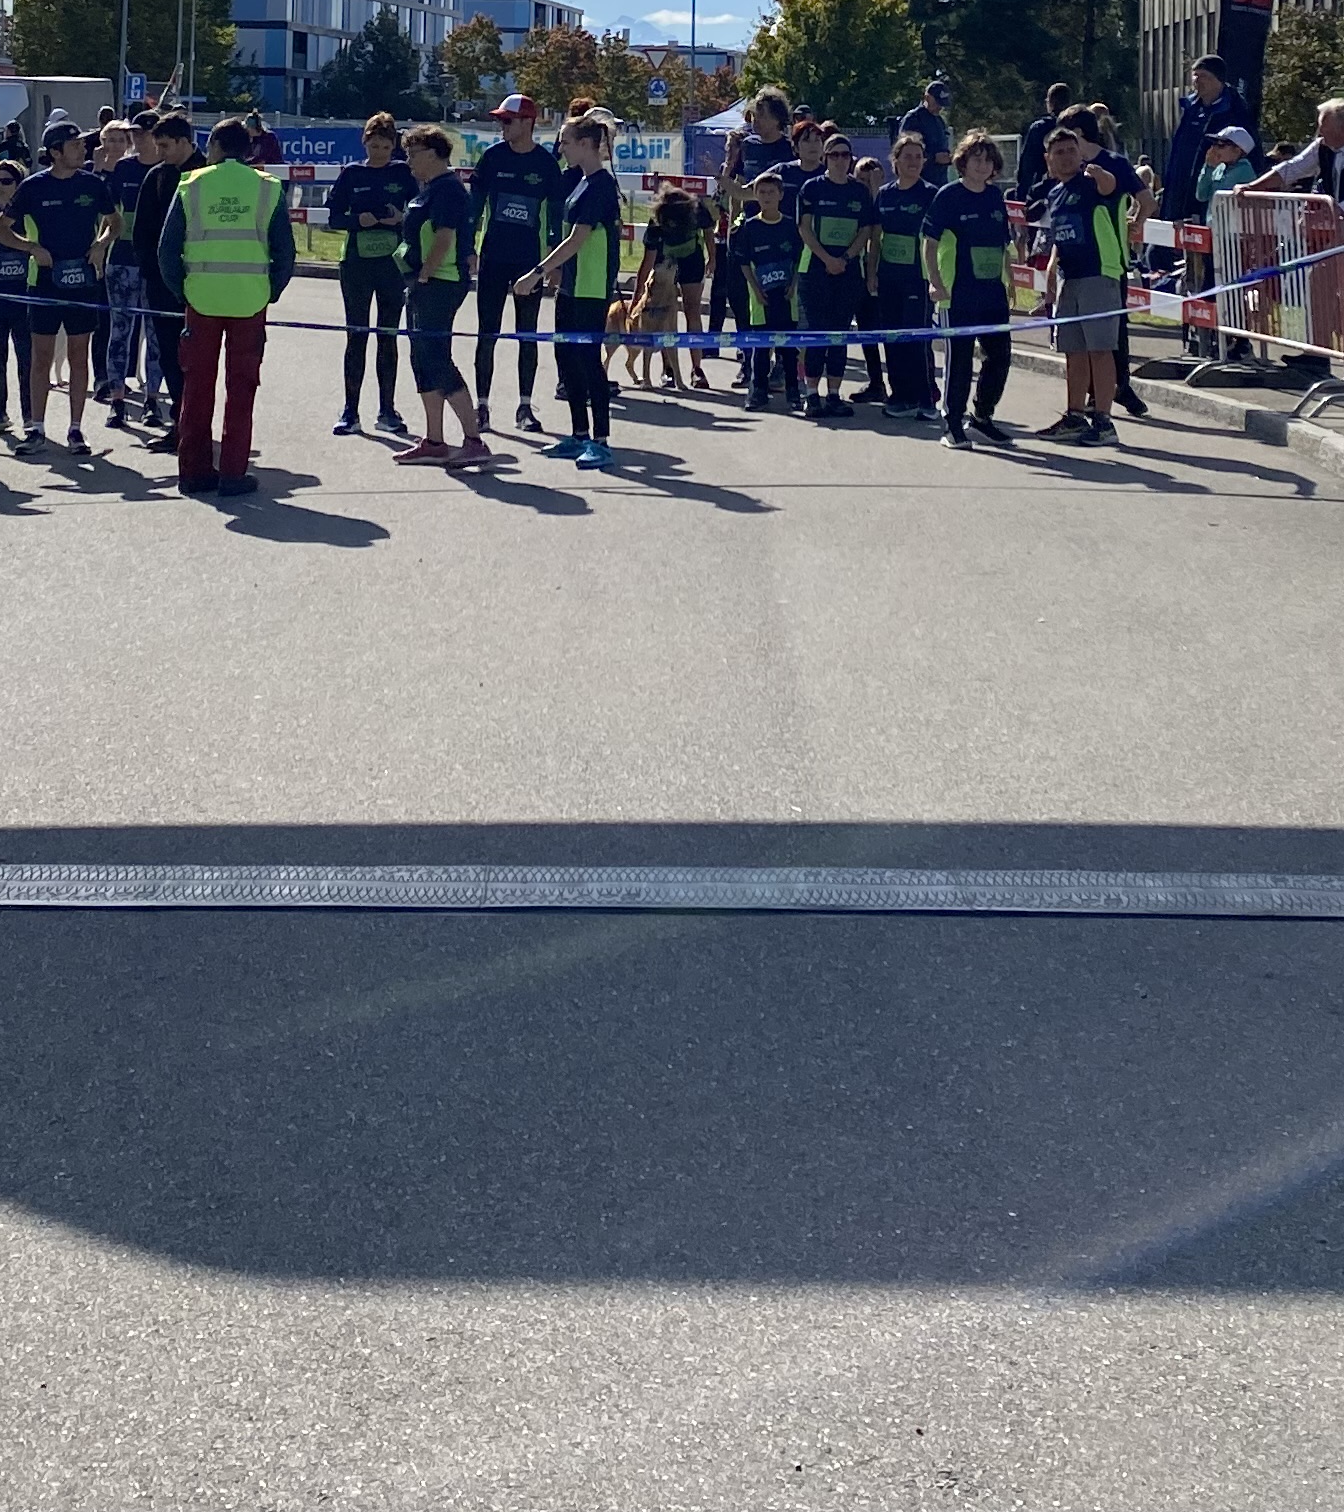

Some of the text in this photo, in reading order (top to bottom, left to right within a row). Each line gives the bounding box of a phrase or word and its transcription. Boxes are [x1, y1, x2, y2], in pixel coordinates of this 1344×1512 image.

[132, 77, 141, 89] P
[282, 136, 336, 155] rcher
[614, 138, 671, 159] ebii!
